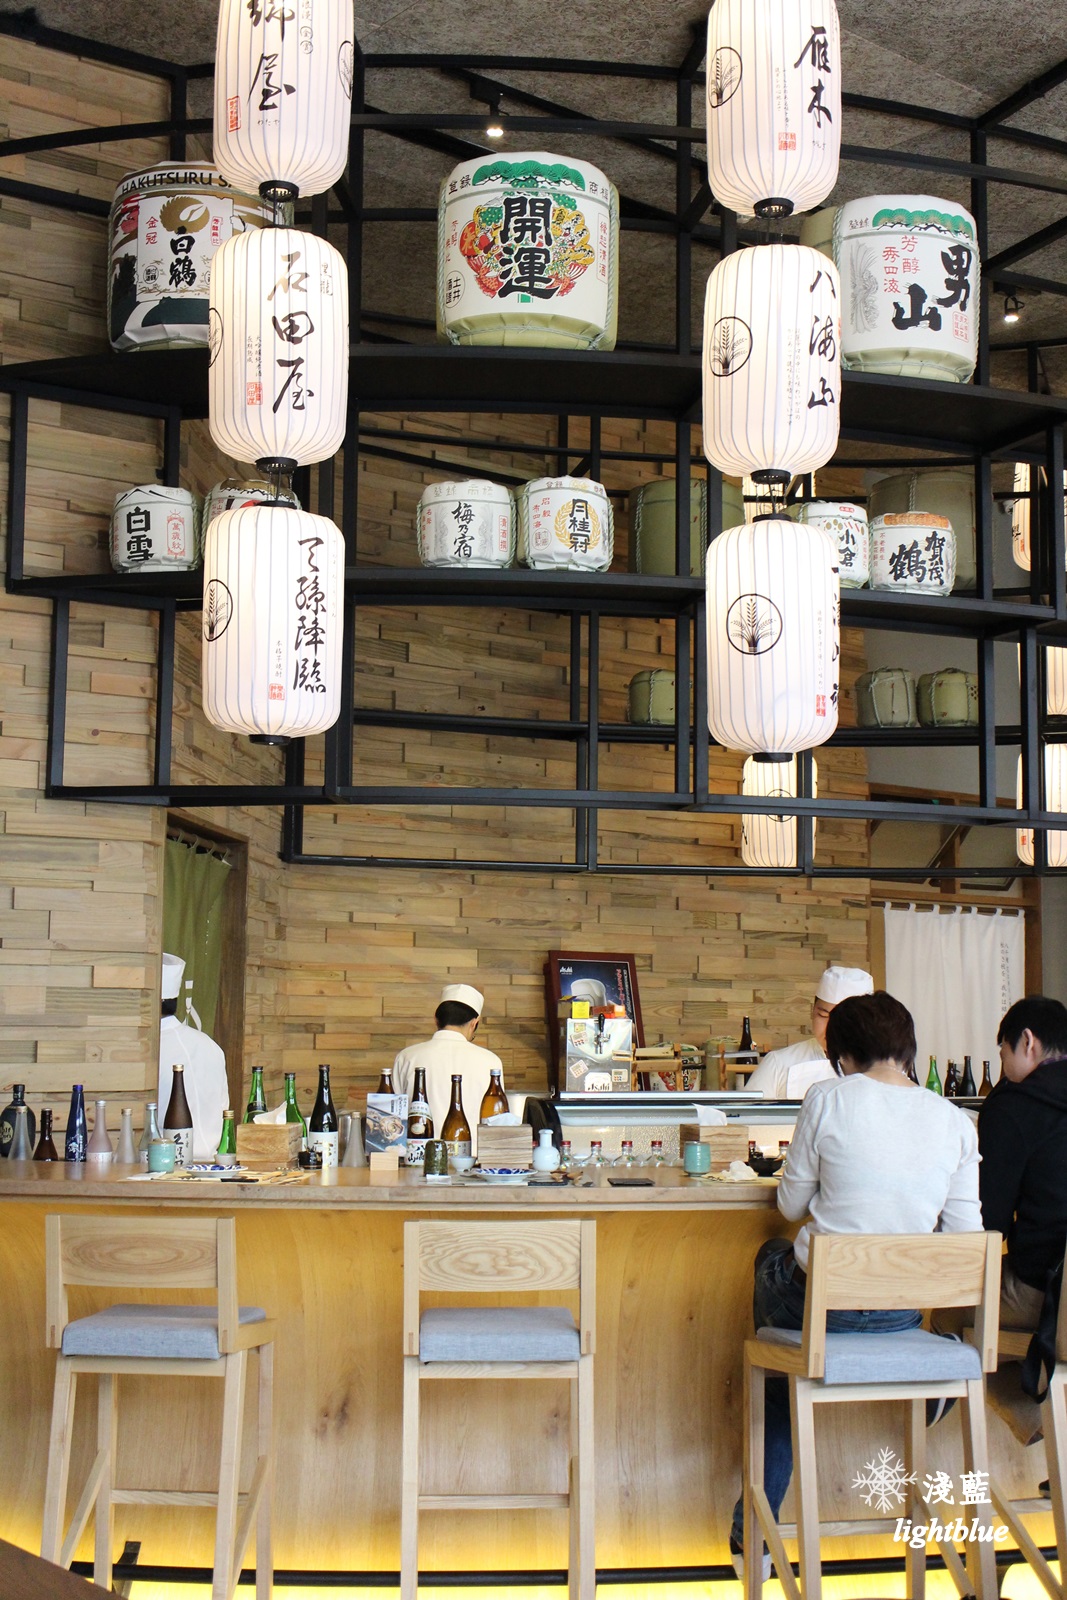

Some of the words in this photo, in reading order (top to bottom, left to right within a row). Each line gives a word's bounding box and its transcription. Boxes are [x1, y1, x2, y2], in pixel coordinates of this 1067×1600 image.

[121, 171, 213, 195] HAKUTSURU
[145, 216, 159, 245] 金冠
[168, 225, 198, 289] 白鶴
[498, 196, 561, 300] 開運
[901, 235, 920, 275] 芳醇
[267, 251, 315, 414] 石田屋
[807, 270, 836, 410] 八海山
[126, 506, 155, 561] 白雪
[451, 501, 476, 559] 梅乃宿
[568, 498, 591, 554] 月桂冠
